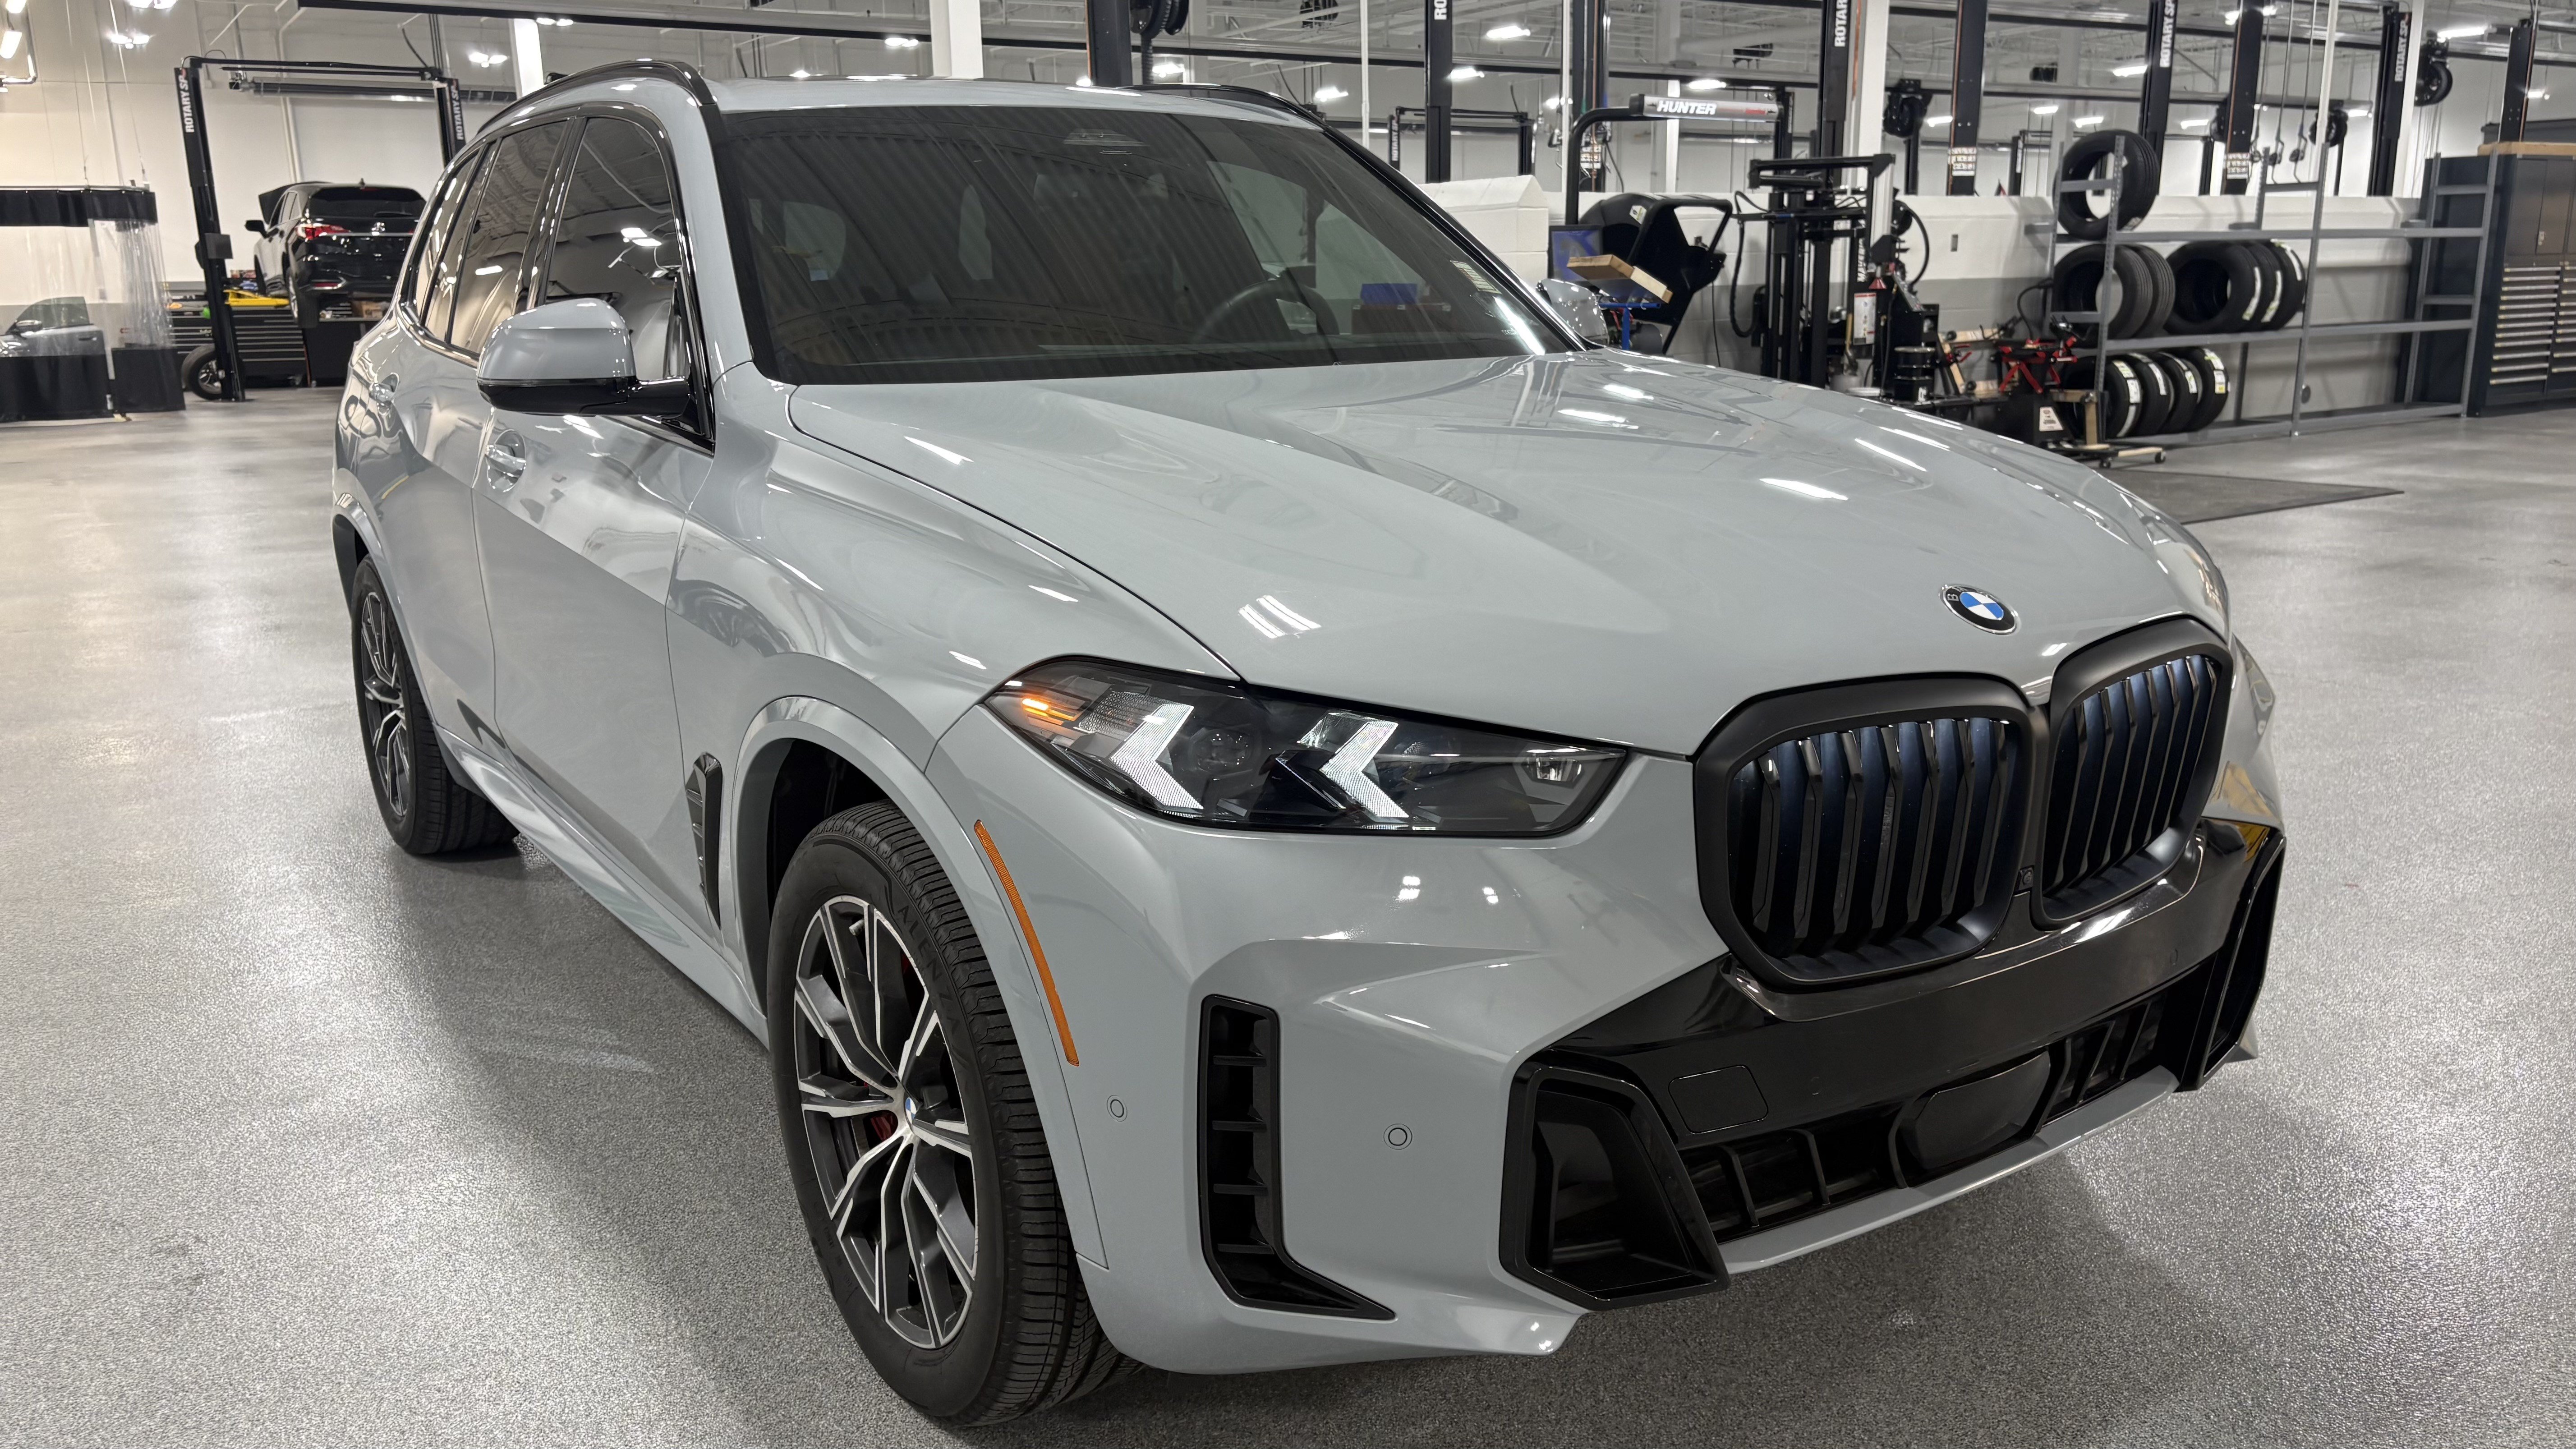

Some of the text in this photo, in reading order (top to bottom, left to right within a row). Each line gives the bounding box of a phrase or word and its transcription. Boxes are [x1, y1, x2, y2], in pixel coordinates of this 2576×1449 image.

[1834, 0, 1848, 47] ROTAR
[2159, 16, 2174, 67] ROTARY
[2394, 37, 2407, 82] ROTARY
[180, 90, 194, 133] ROTARY
[452, 100, 464, 140] ROTARY
[1656, 100, 1717, 115] HUNTER
[897, 905, 961, 1035] ALENZA
